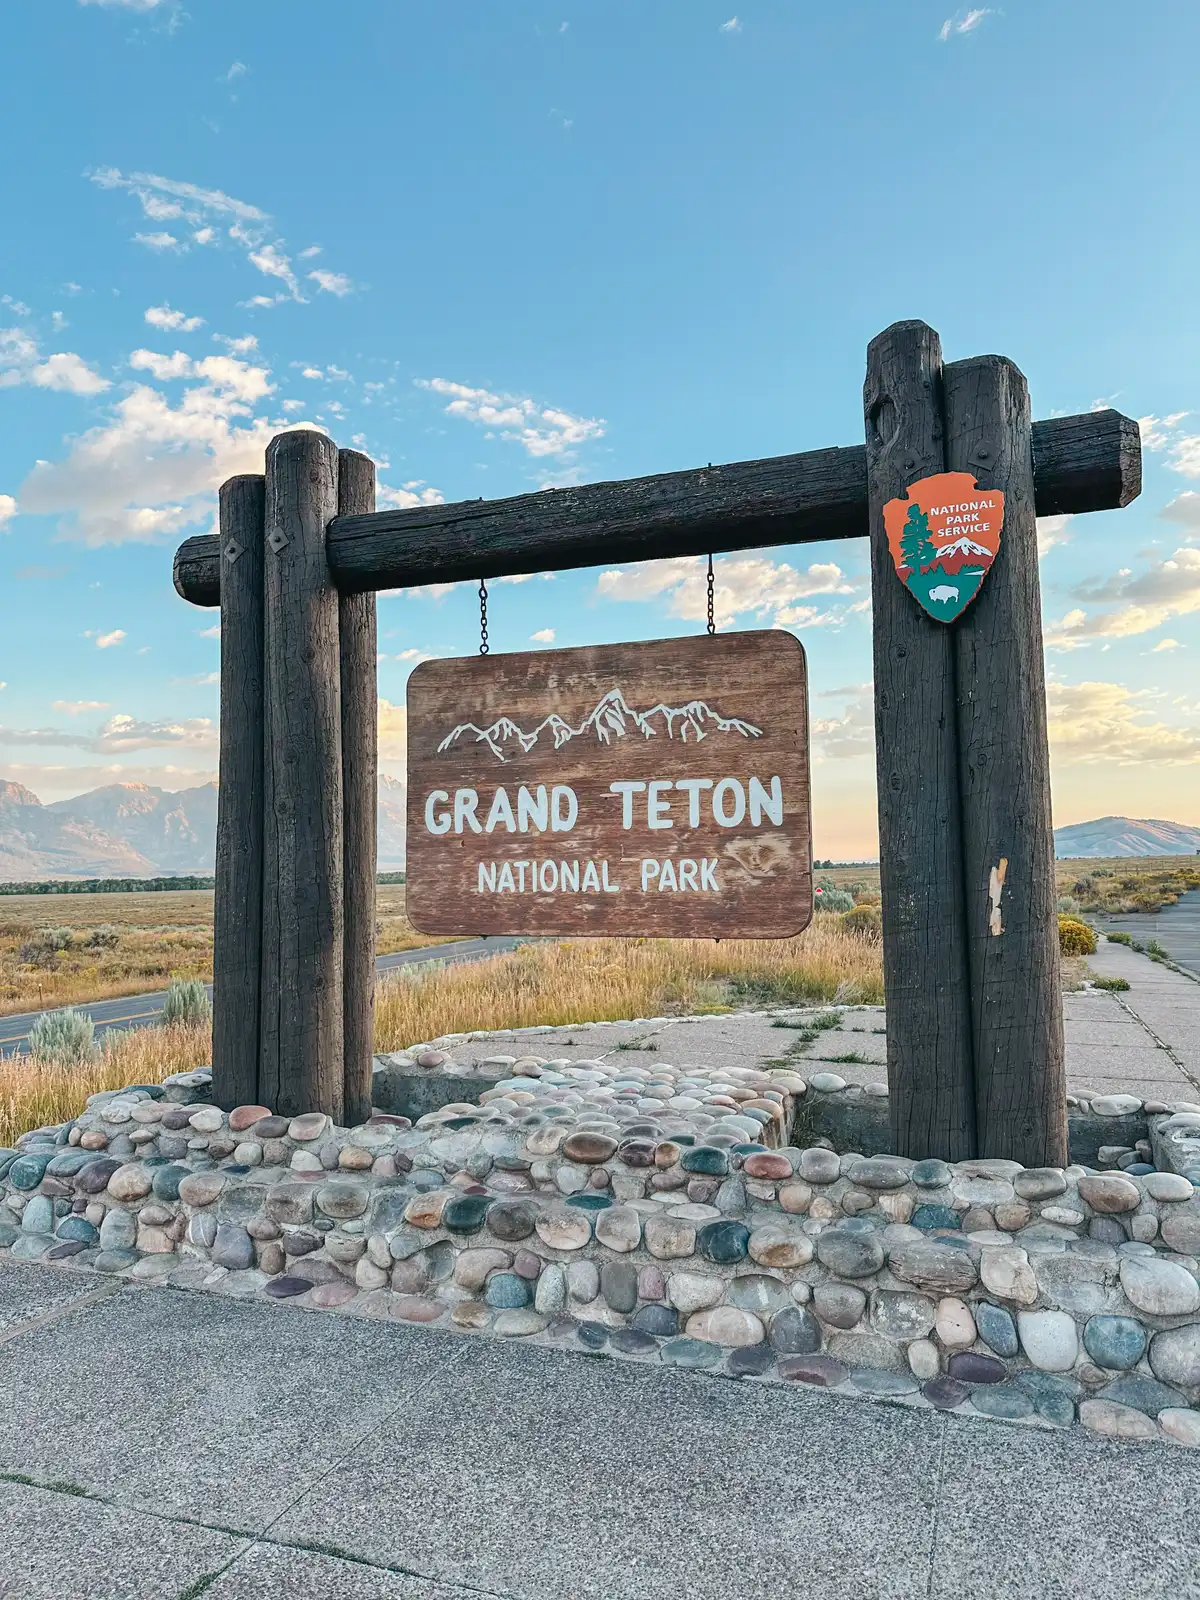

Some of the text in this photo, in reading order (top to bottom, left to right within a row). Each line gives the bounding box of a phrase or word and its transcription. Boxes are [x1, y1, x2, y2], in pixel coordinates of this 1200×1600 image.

[930, 500, 996, 516] NATIONAL
[946, 512, 980, 525] PARK
[937, 523, 990, 538] SERVICE
[424, 775, 784, 836] GRAND TETON
[478, 857, 720, 893] NATIONAL PARK
